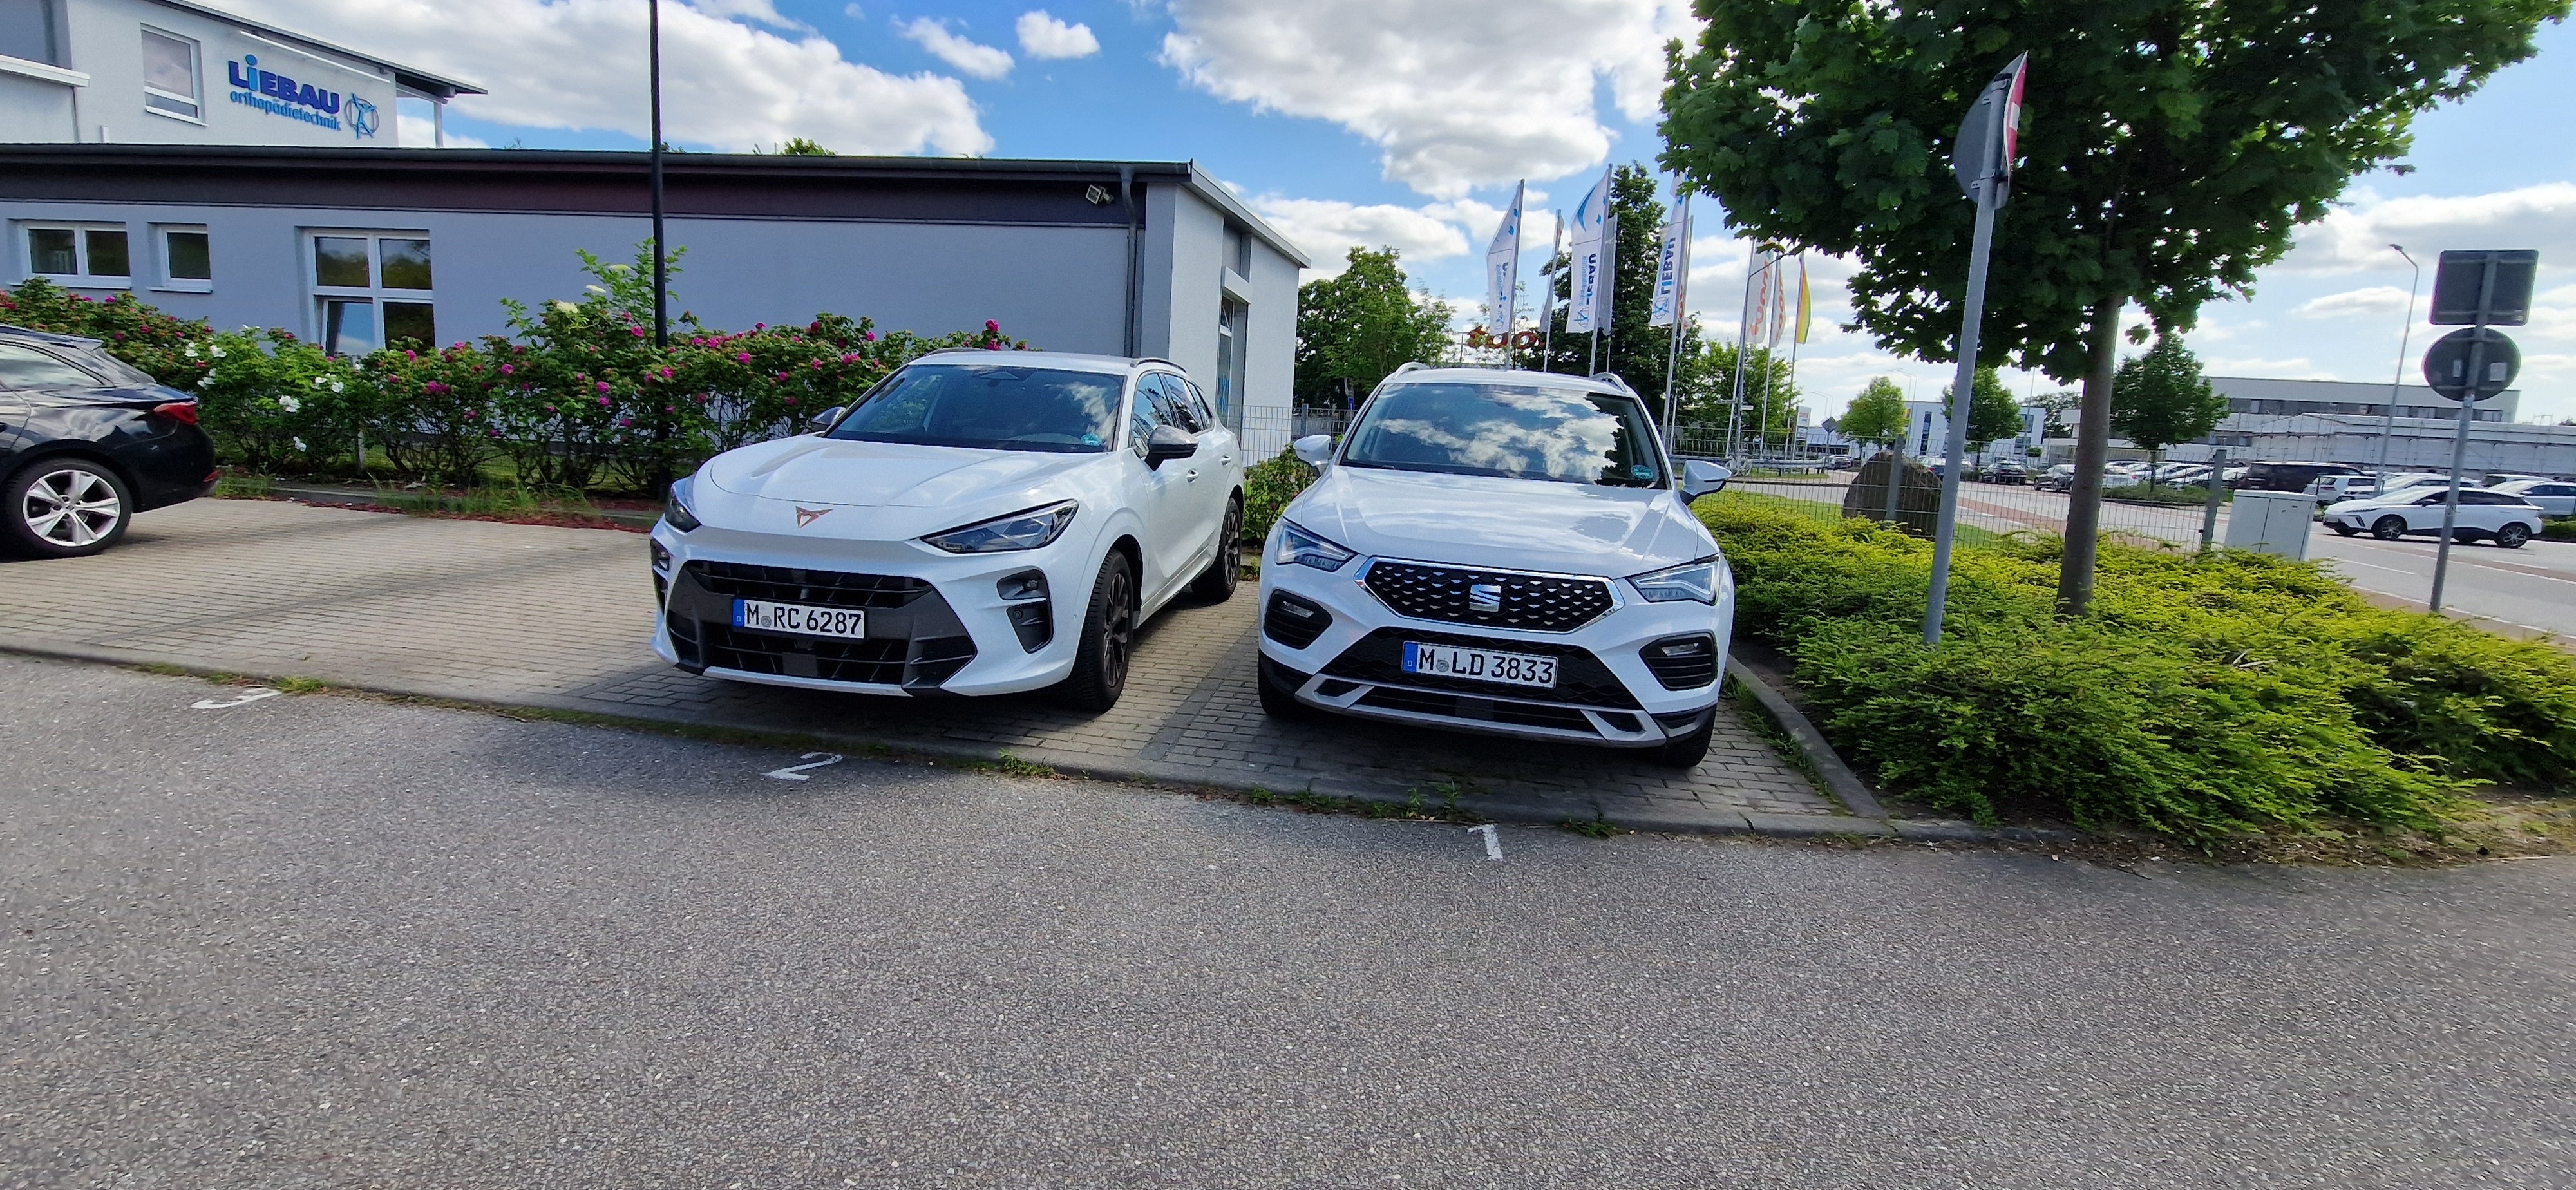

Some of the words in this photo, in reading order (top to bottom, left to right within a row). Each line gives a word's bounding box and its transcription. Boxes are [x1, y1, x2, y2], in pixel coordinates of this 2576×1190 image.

[230, 91, 341, 131] orthopädietechnik
[746, 603, 759, 625] M
[773, 606, 800, 629] RC
[806, 610, 862, 634] 6287
[1419, 648, 1435, 670] M
[1452, 651, 1484, 676] LD
[1490, 655, 1553, 684] 3833
[760, 751, 844, 781] 2
[1466, 824, 1504, 862] 1
